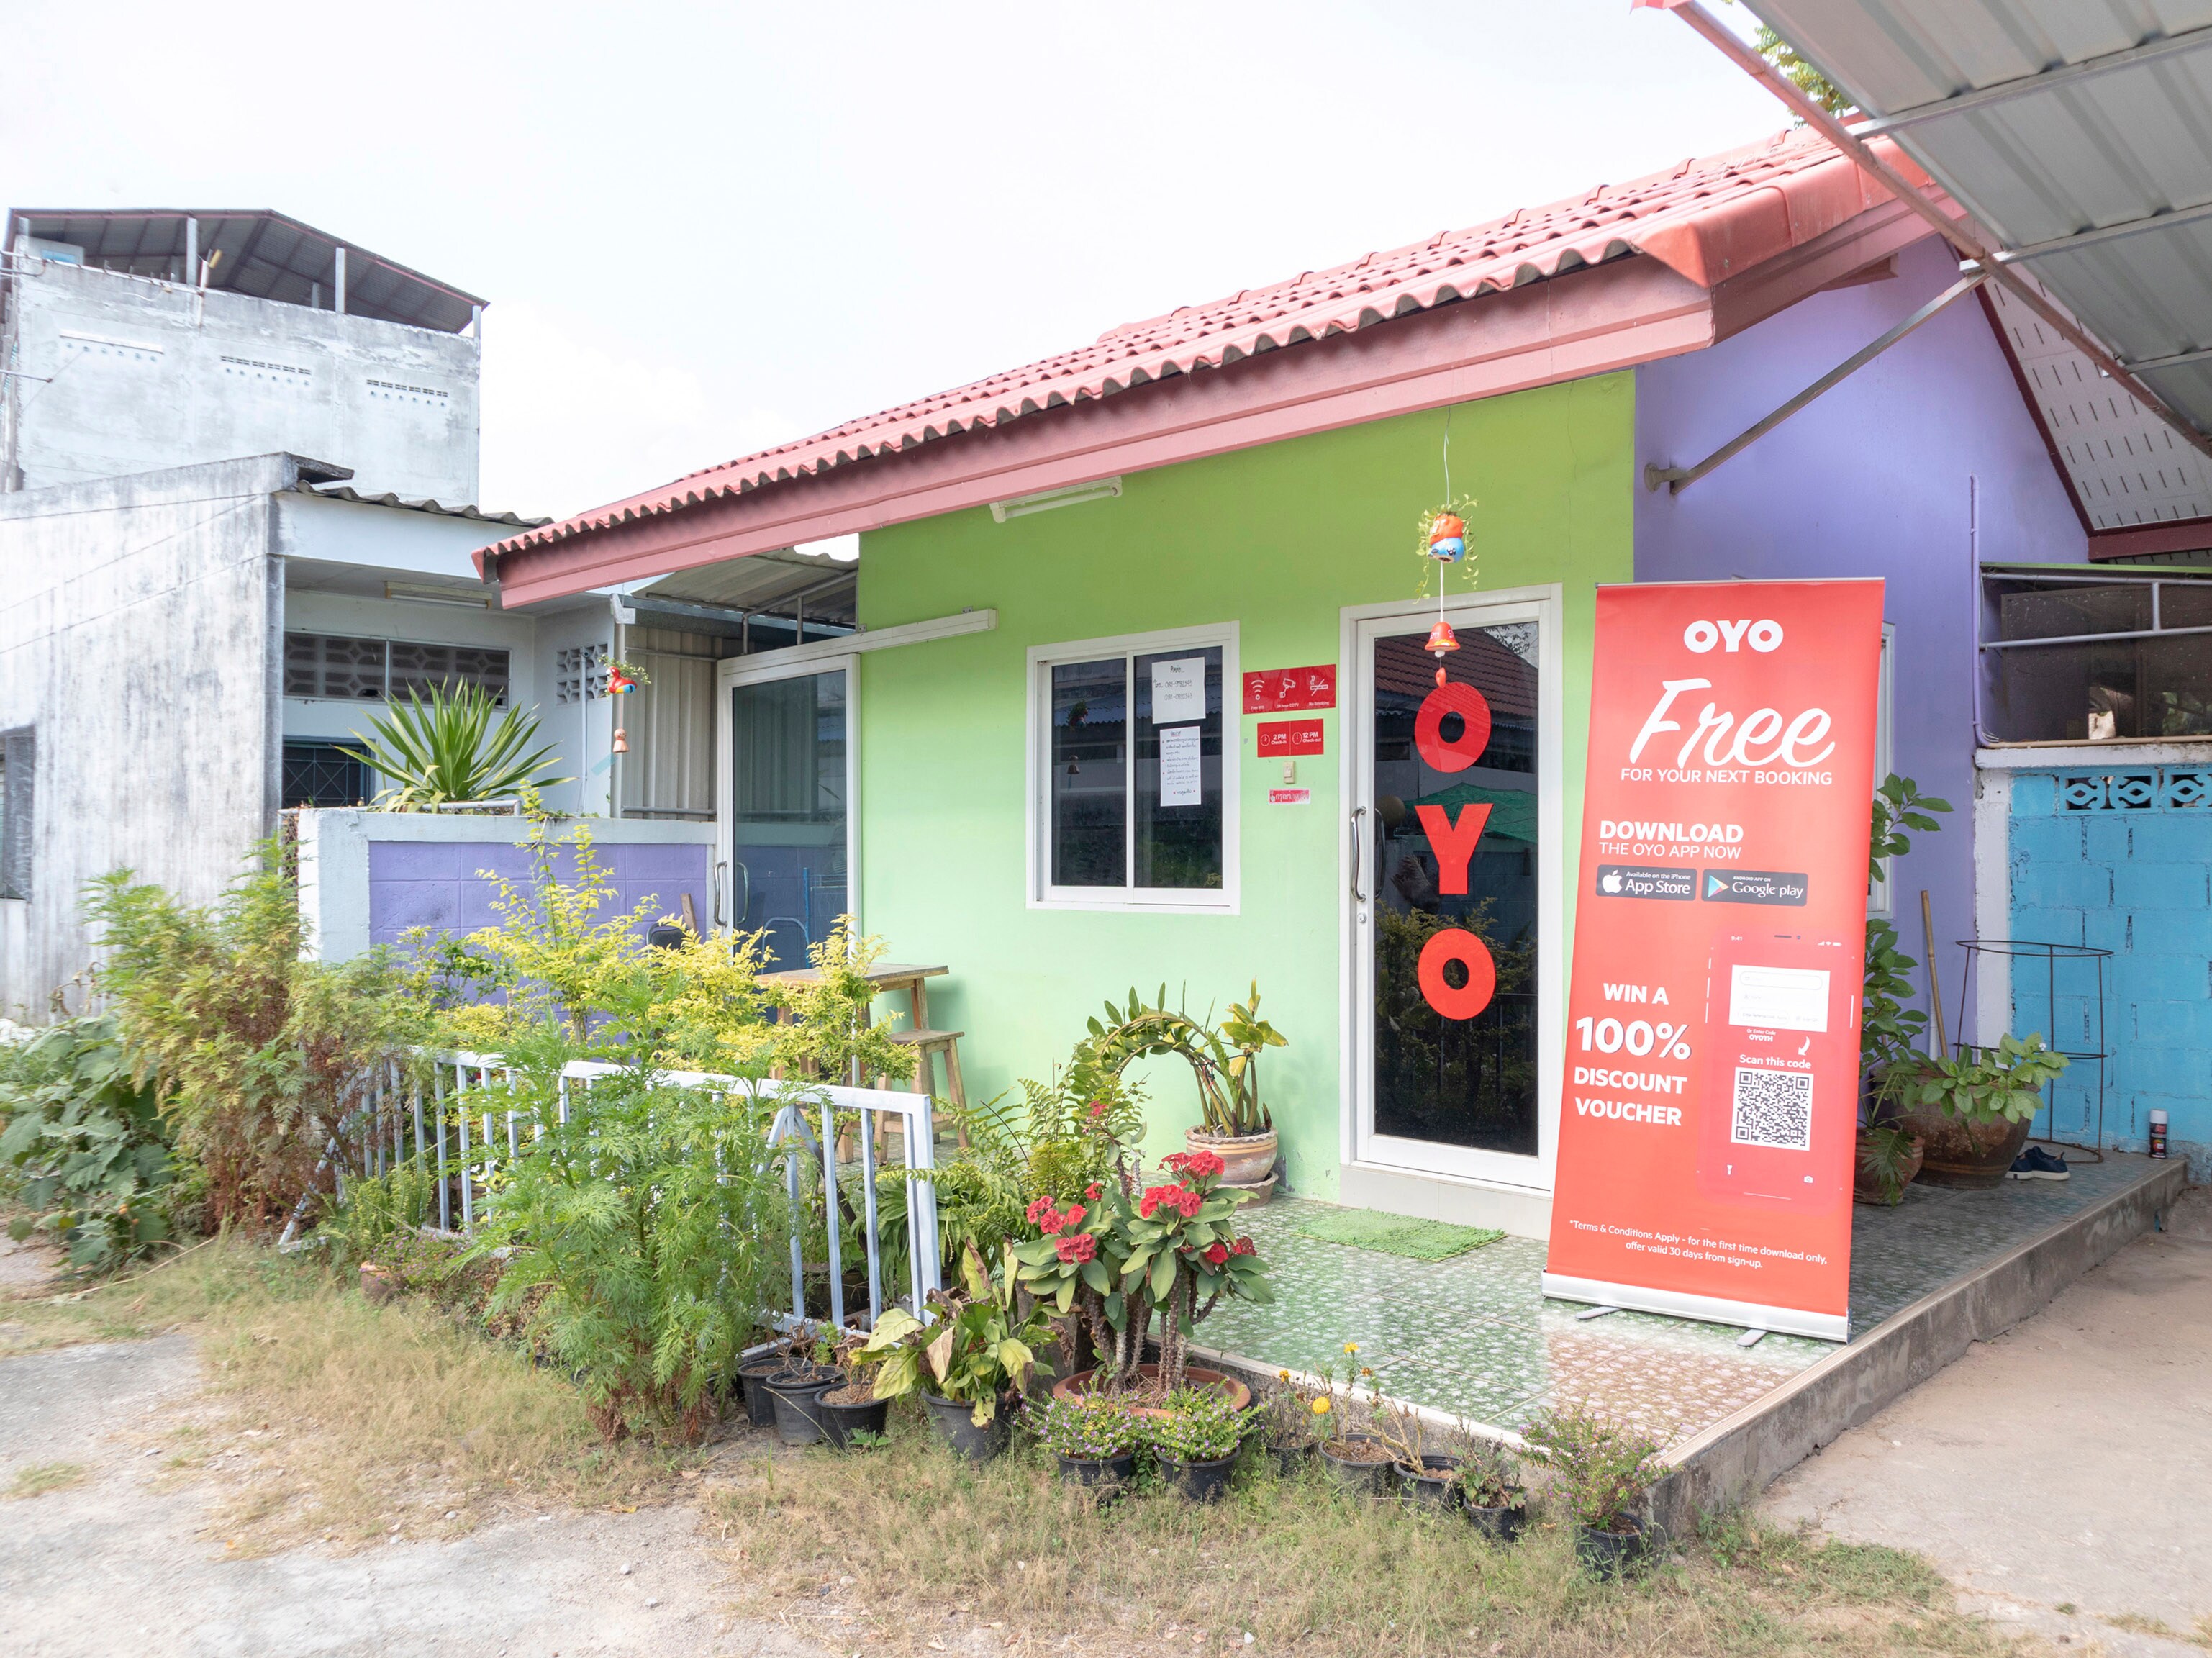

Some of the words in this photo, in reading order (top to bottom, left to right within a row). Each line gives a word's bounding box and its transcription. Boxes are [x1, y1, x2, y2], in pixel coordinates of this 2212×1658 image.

[1684, 620, 1784, 653] OYO
[1629, 678, 1835, 769] Free
[1621, 769, 1652, 781] FOR
[1657, 769, 1701, 782] YOUR
[1706, 770, 1749, 783] NEXT
[1754, 771, 1832, 785] BOOKING
[1600, 820, 1744, 843] DOWNLOAD
[1599, 842, 1629, 854] THE
[1633, 843, 1665, 856] OYO
[1669, 845, 1700, 858] APP
[1703, 846, 1741, 859] NOW
[1625, 879, 1654, 895] App
[1656, 880, 1690, 894] Store
[1732, 881, 1776, 898] Google
[1779, 884, 1803, 899] play
[1603, 982, 1647, 1003] WIN
[1651, 987, 1669, 1005] A
[1576, 1016, 1692, 1060] 100%
[1739, 1054, 1763, 1065] Scan
[1766, 1056, 1785, 1066] this
[1787, 1059, 1811, 1069] code
[1574, 1066, 1687, 1094] DISCOUNT
[1575, 1097, 1682, 1125] VOUCHER
[1600, 1224, 1606, 1233] &
[1608, 1226, 1653, 1239] Conditions
[1654, 1232, 1680, 1244] Apply
[1687, 1236, 1700, 1246] for
[1703, 1238, 1716, 1248] the
[1718, 1240, 1736, 1251] first
[1739, 1244, 1758, 1254] time
[1760, 1246, 1804, 1260] download
[1805, 1254, 1827, 1264] only,
[1626, 1241, 1645, 1251] offer
[1647, 1245, 1667, 1254] valid
[1669, 1246, 1680, 1256] 30
[1682, 1249, 1703, 1260] days
[1705, 1251, 1725, 1262] from
[1727, 1256, 1762, 1269] sign-up.
